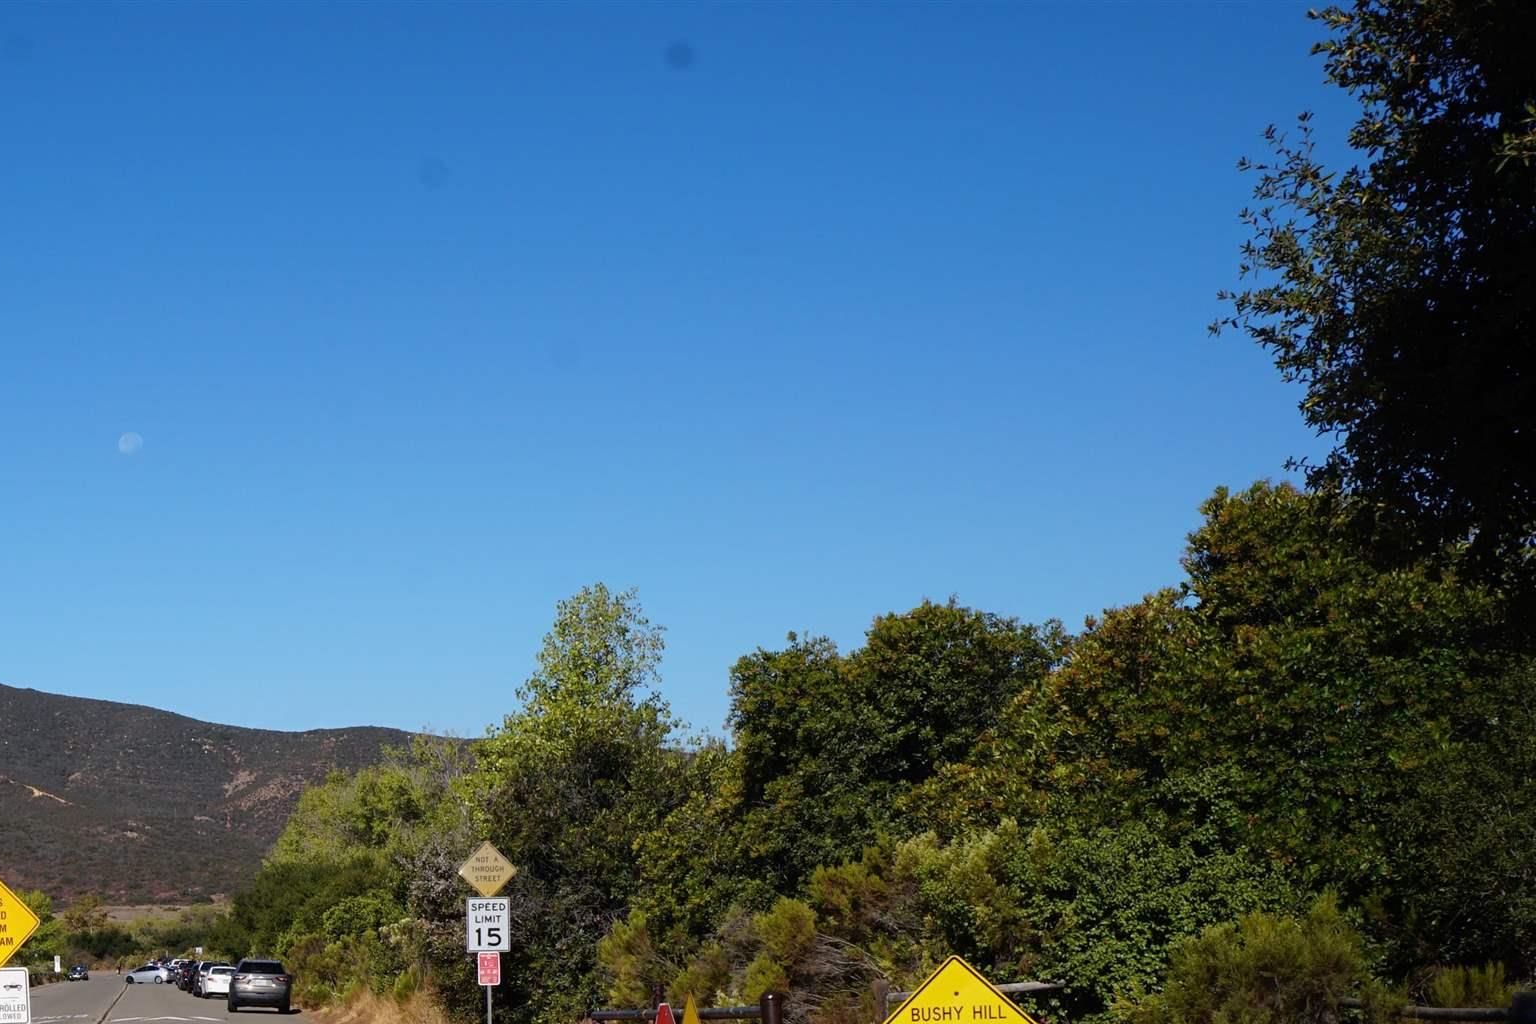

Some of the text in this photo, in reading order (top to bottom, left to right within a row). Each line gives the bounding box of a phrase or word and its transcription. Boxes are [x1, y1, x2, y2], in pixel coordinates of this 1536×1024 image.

[471, 865, 504, 873] THROUGH
[471, 902, 506, 912] SPEED
[475, 914, 501, 924] LIMIT
[475, 927, 502, 947] 15
[911, 1005, 1007, 1022] BUSHY HILL
